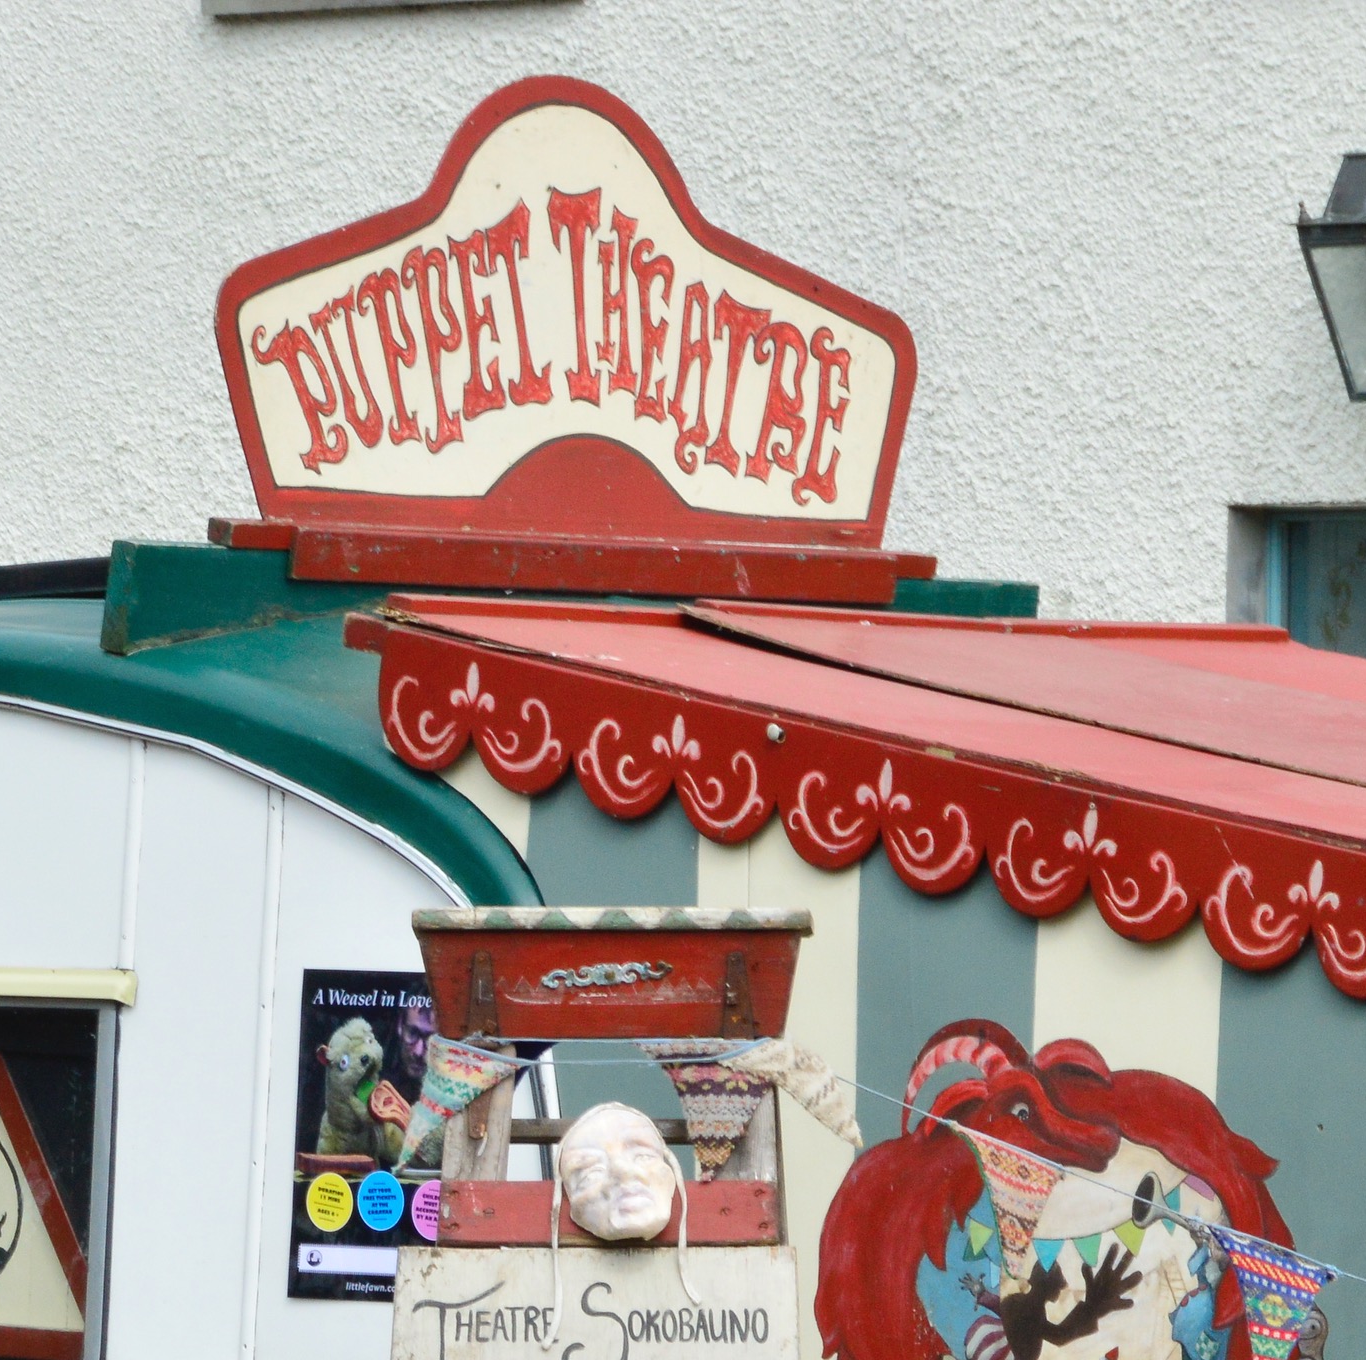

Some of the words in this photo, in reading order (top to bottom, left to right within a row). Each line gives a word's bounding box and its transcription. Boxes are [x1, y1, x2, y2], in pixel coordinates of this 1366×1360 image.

[251, 198, 552, 474] PUPPET
[548, 186, 851, 505] THEATRE
[313, 988, 324, 1005] A
[329, 988, 378, 1006] Weasel
[381, 990, 395, 1007] in
[399, 990, 432, 1008] Love
